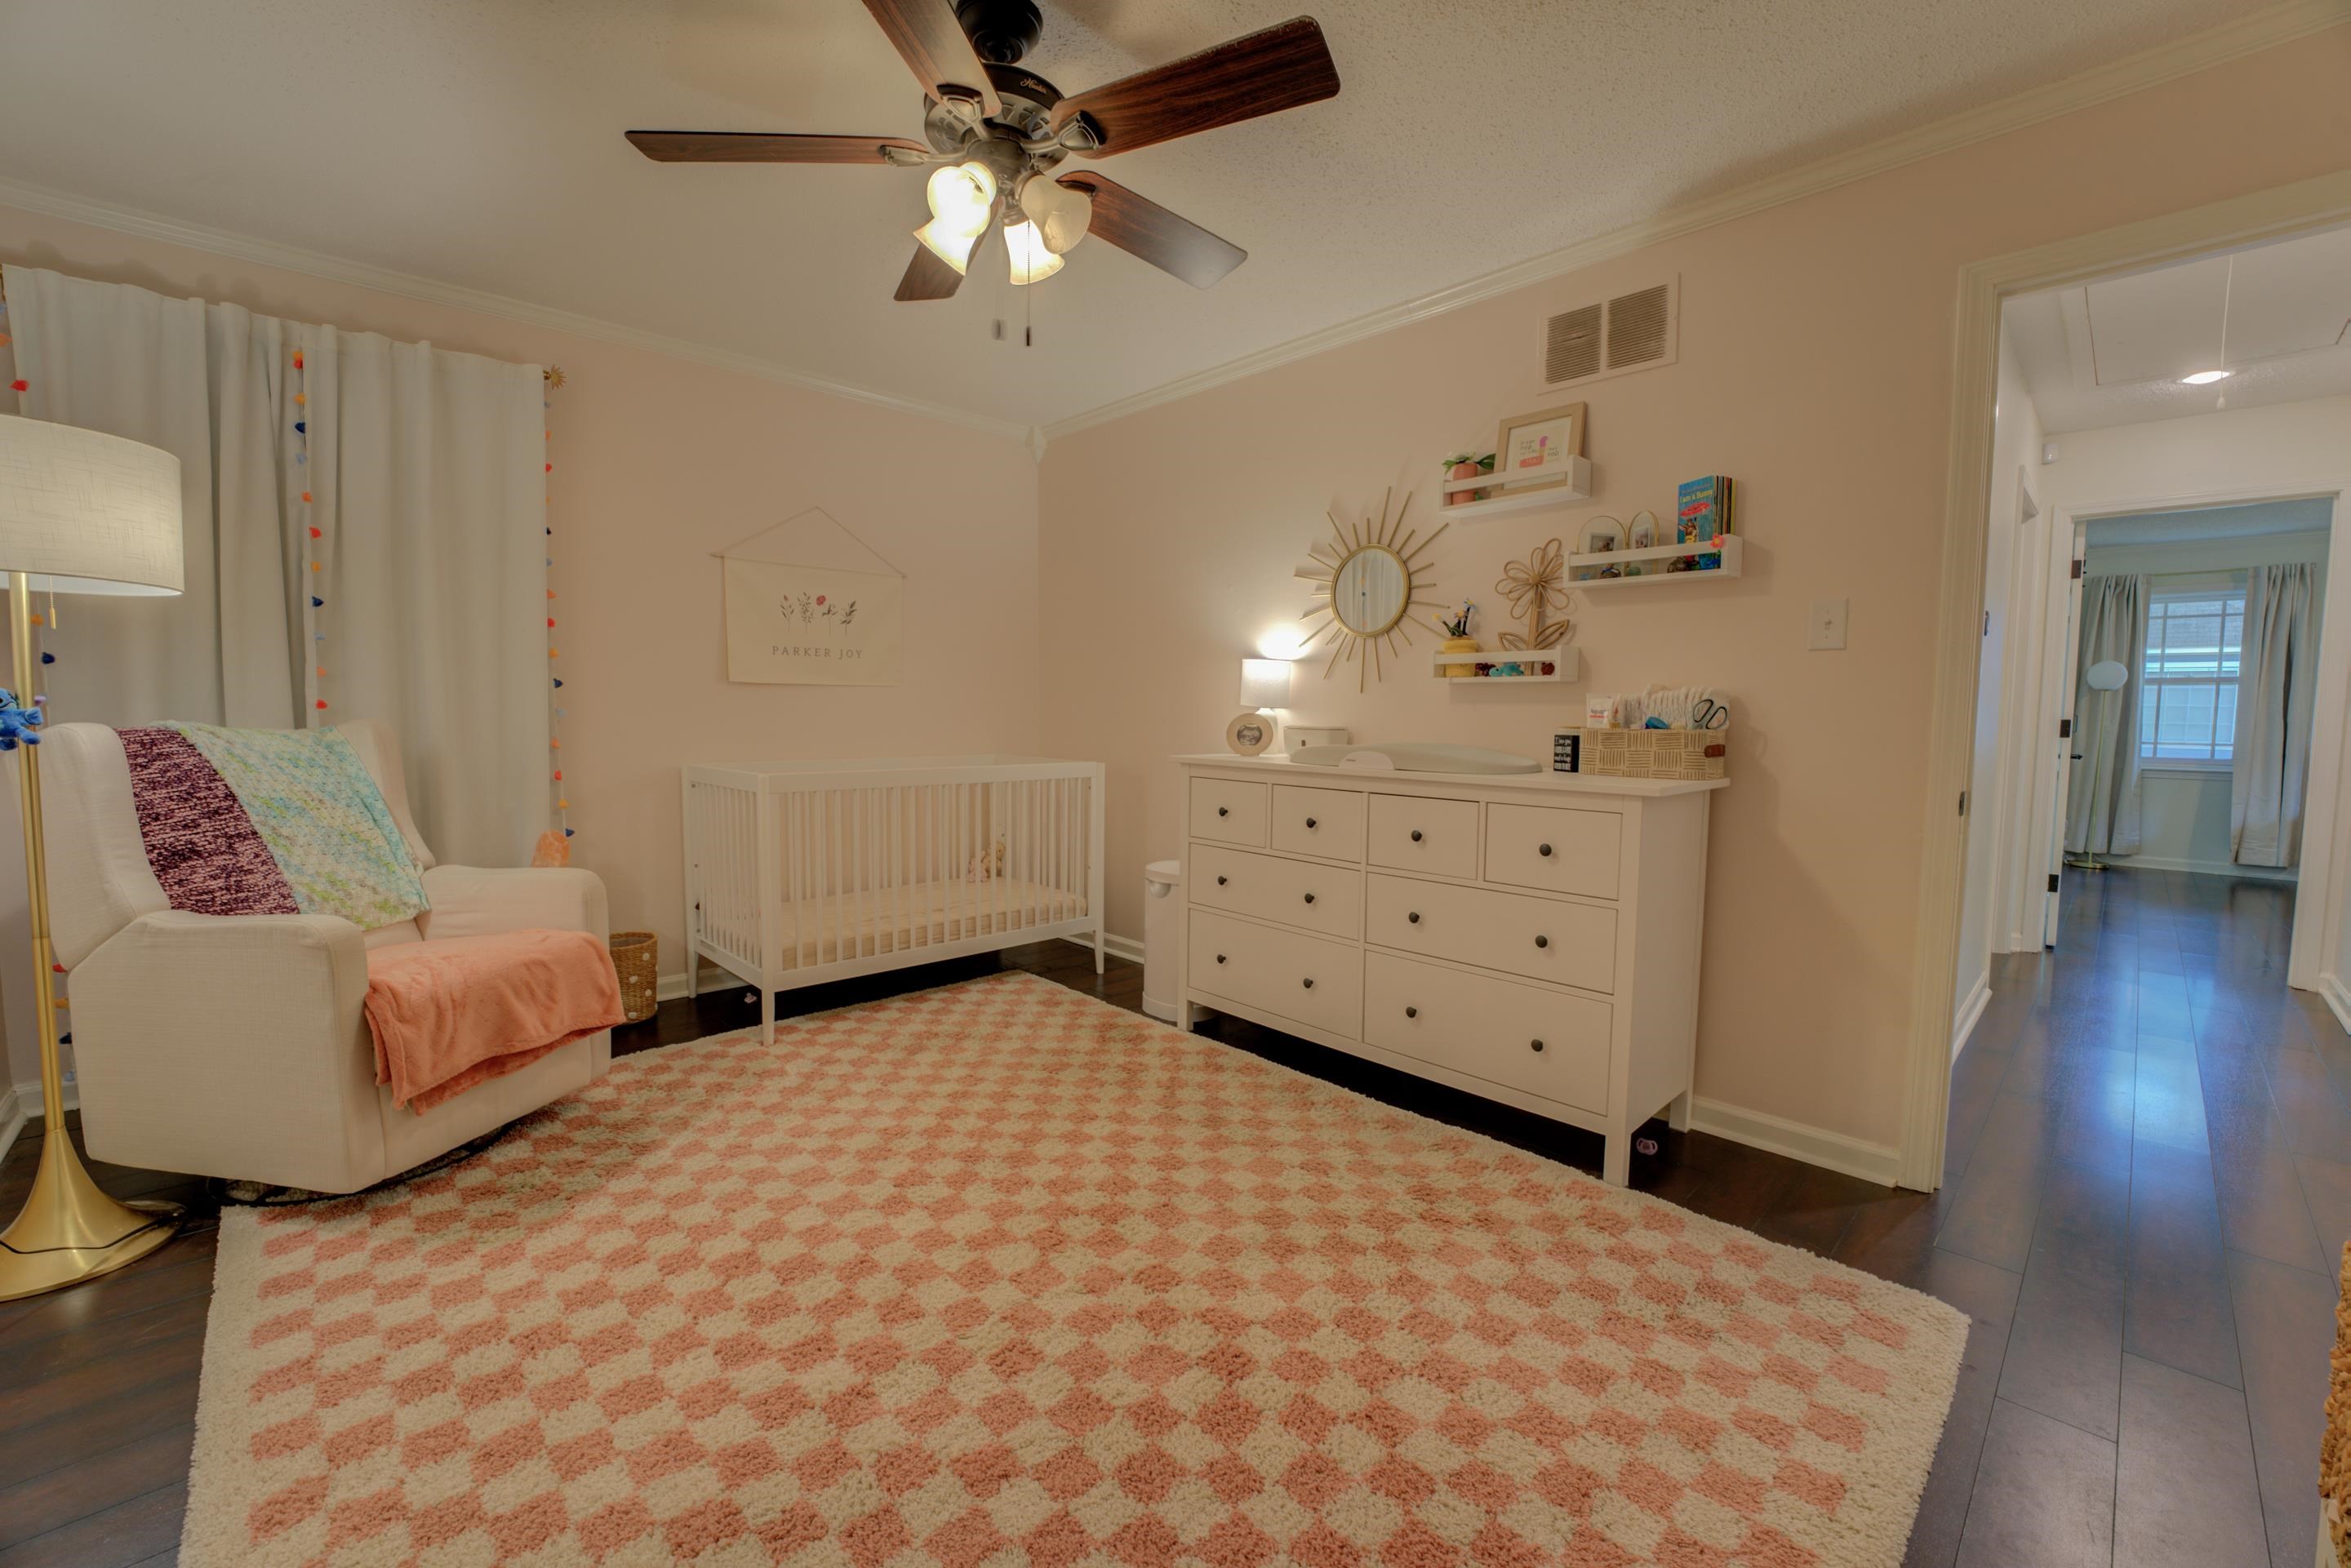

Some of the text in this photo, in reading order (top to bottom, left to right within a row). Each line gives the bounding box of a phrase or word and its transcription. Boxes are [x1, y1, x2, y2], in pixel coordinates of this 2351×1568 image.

[1696, 489, 1713, 499] Bunny
[771, 646, 862, 660] PARKER JOY
